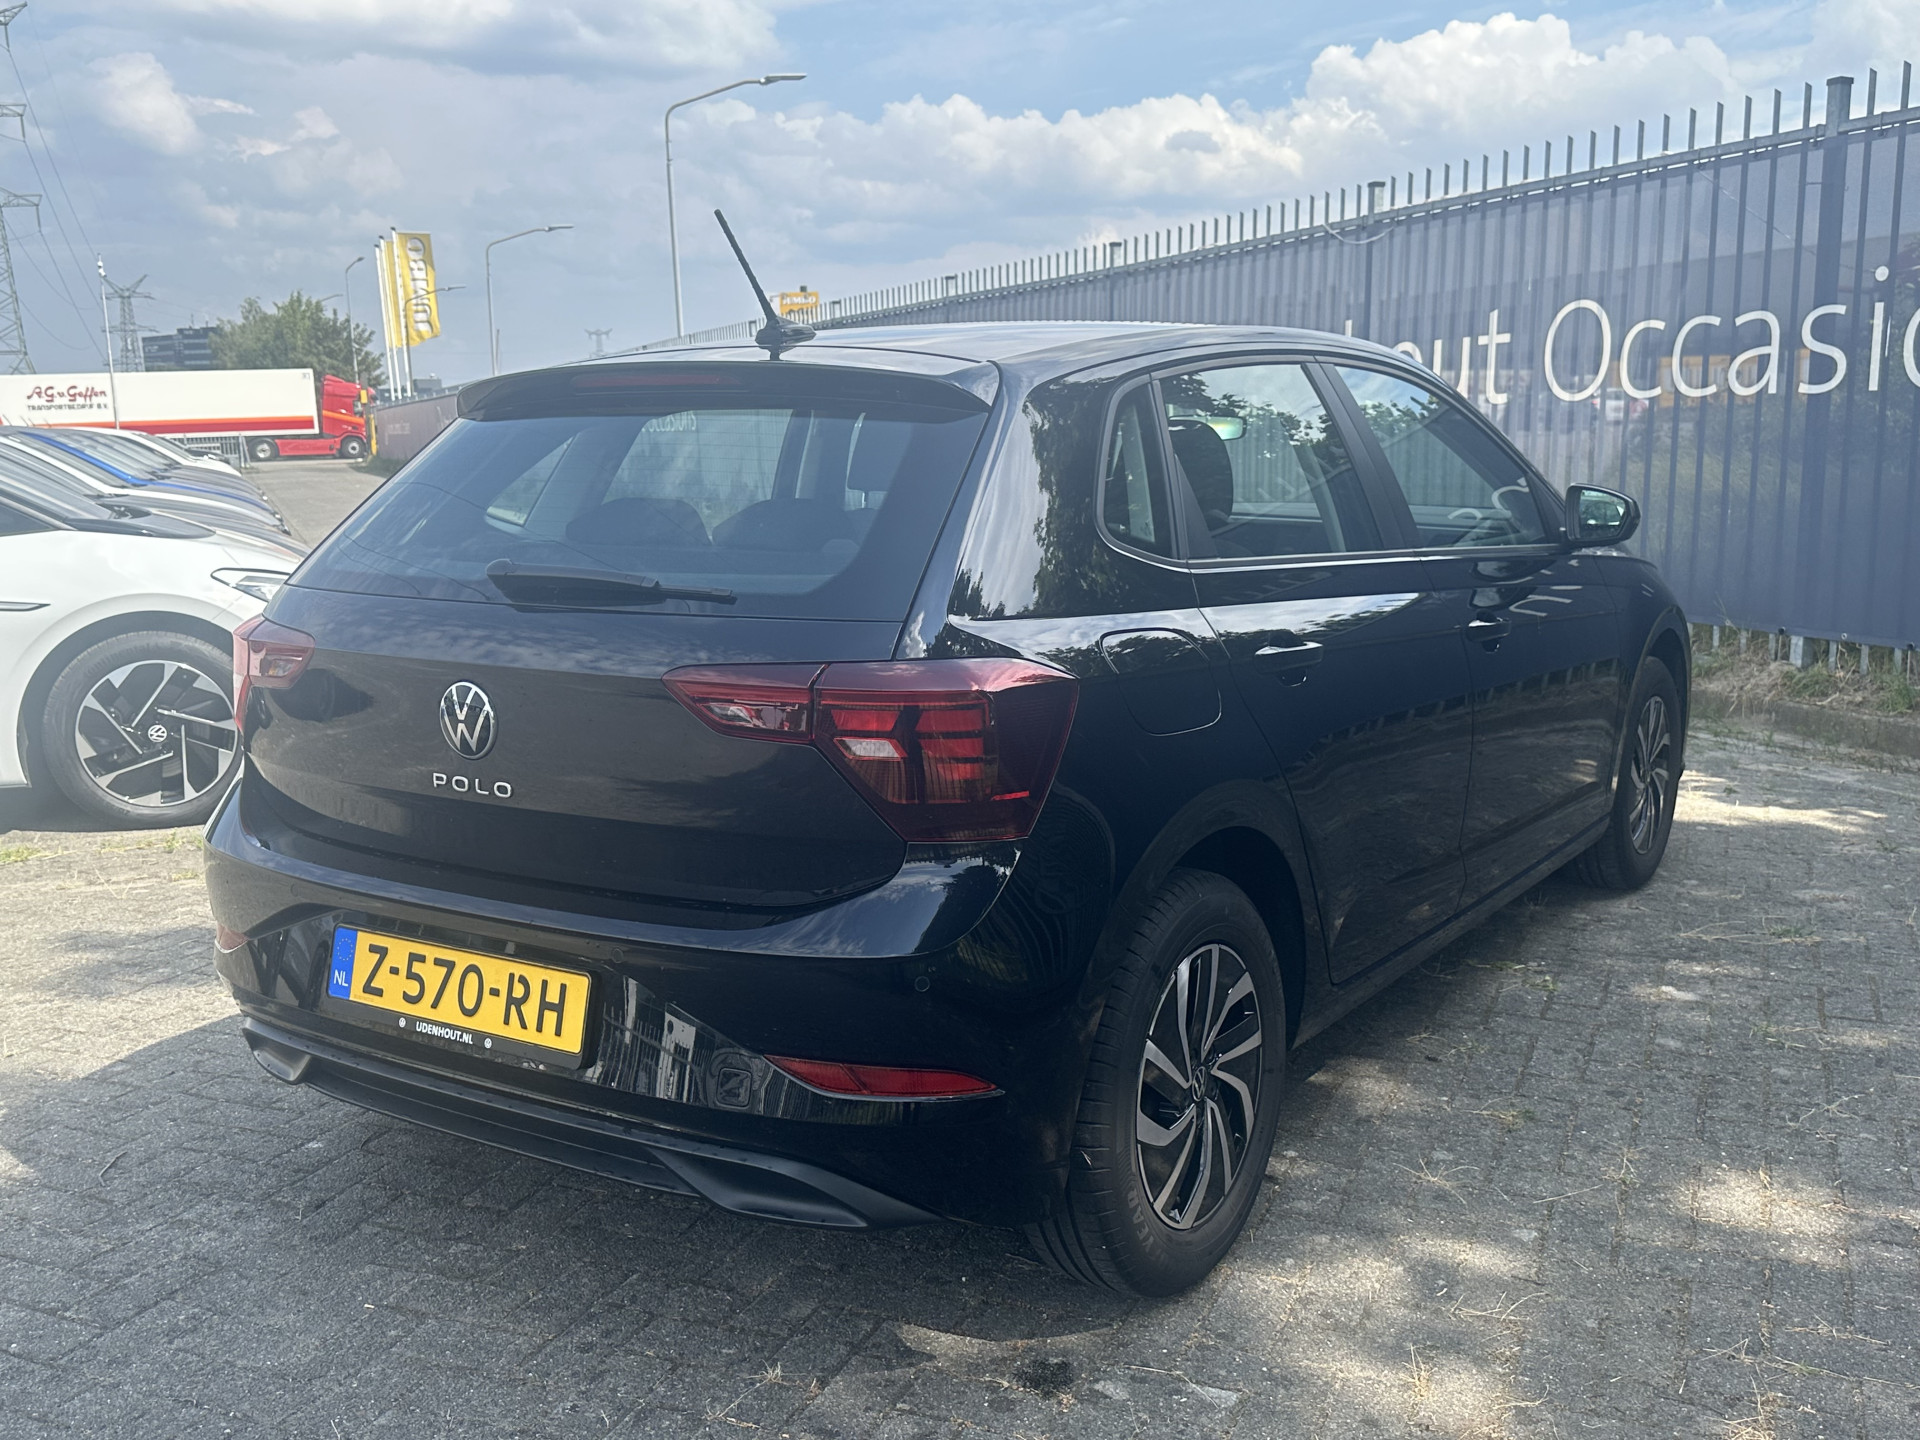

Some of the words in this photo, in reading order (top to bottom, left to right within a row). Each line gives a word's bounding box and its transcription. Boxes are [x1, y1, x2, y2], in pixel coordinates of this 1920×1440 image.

[407, 237, 433, 334] JUMBO
[432, 772, 512, 798] POLO
[333, 969, 349, 987] NL
[362, 943, 567, 1037] Z-570-RH
[415, 1021, 473, 1045] UDENHOUT.NL
